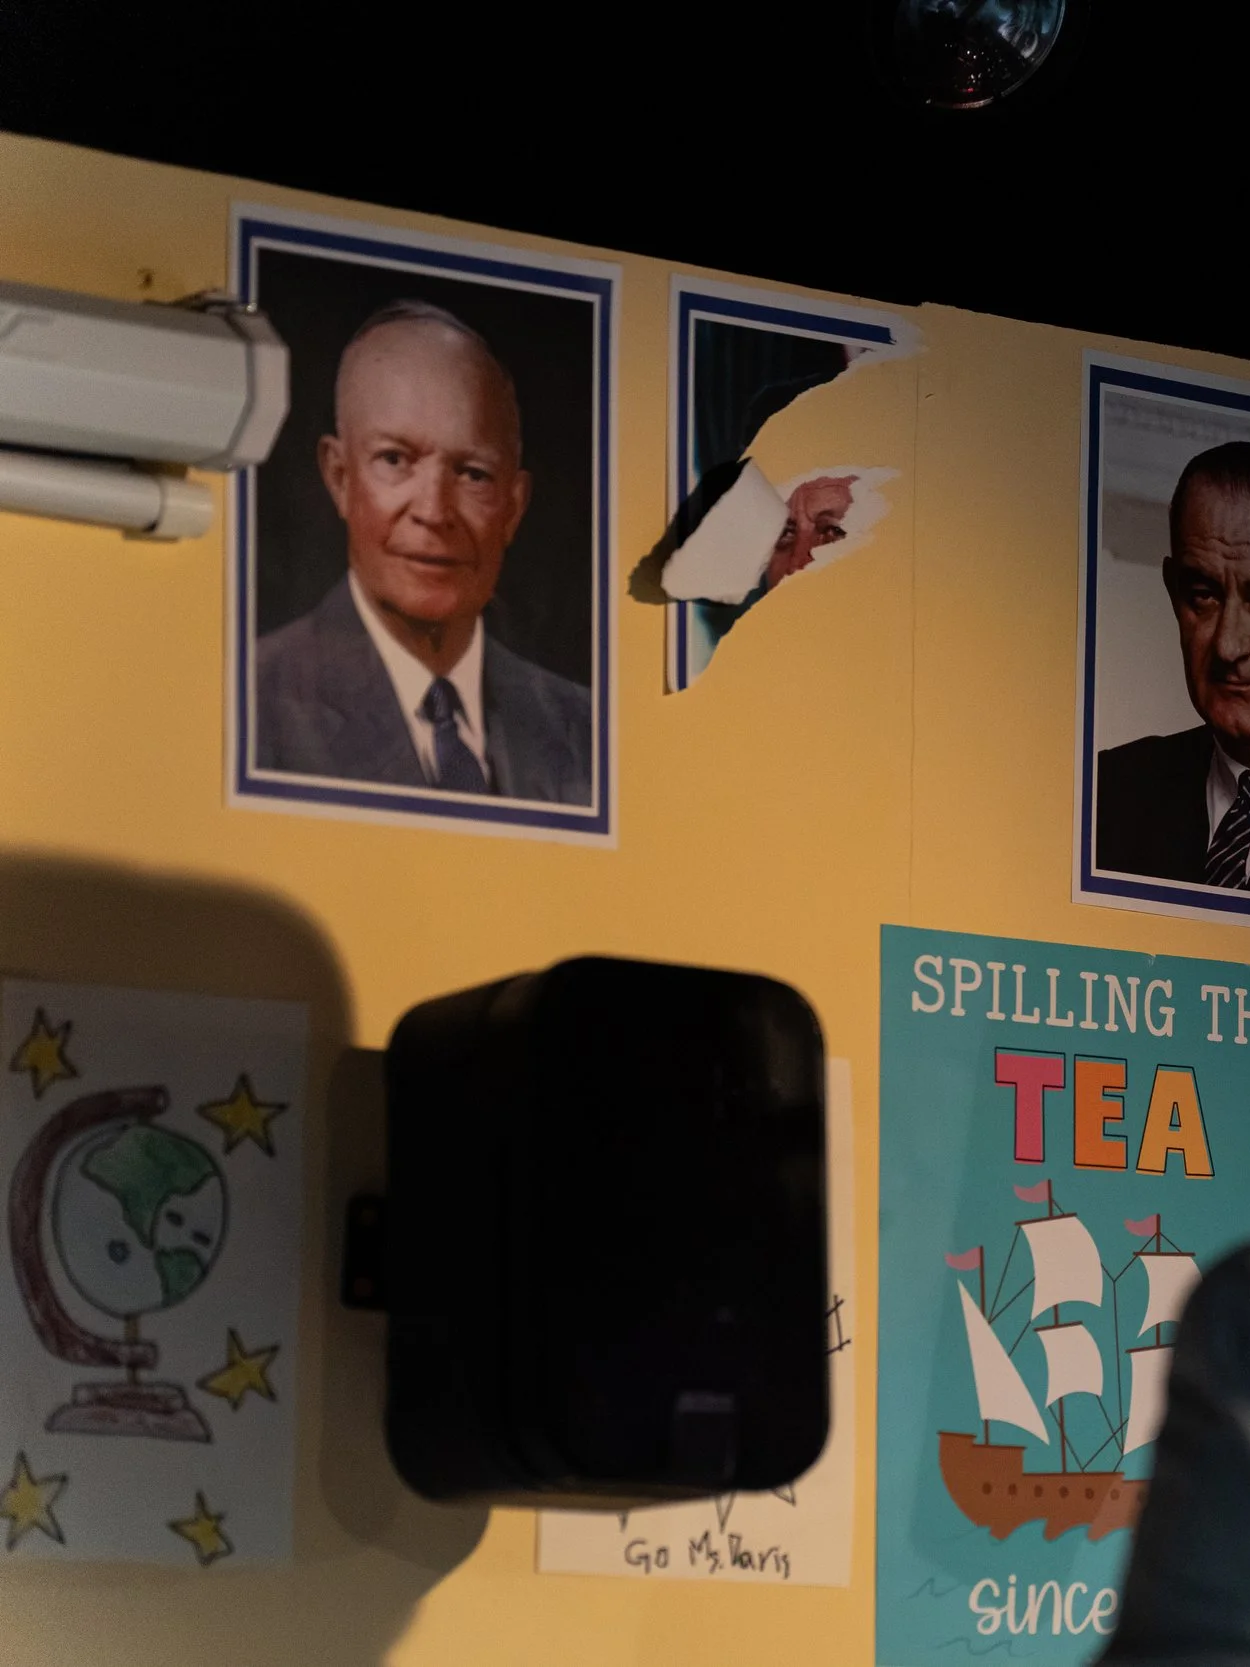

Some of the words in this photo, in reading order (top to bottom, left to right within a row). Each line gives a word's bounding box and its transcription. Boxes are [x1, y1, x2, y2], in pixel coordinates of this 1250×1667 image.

[911, 954, 1176, 1037] SPILLING
[994, 1046, 1216, 1180] TEA
[624, 1539, 670, 1575] Go
[968, 1573, 1119, 1636] since
